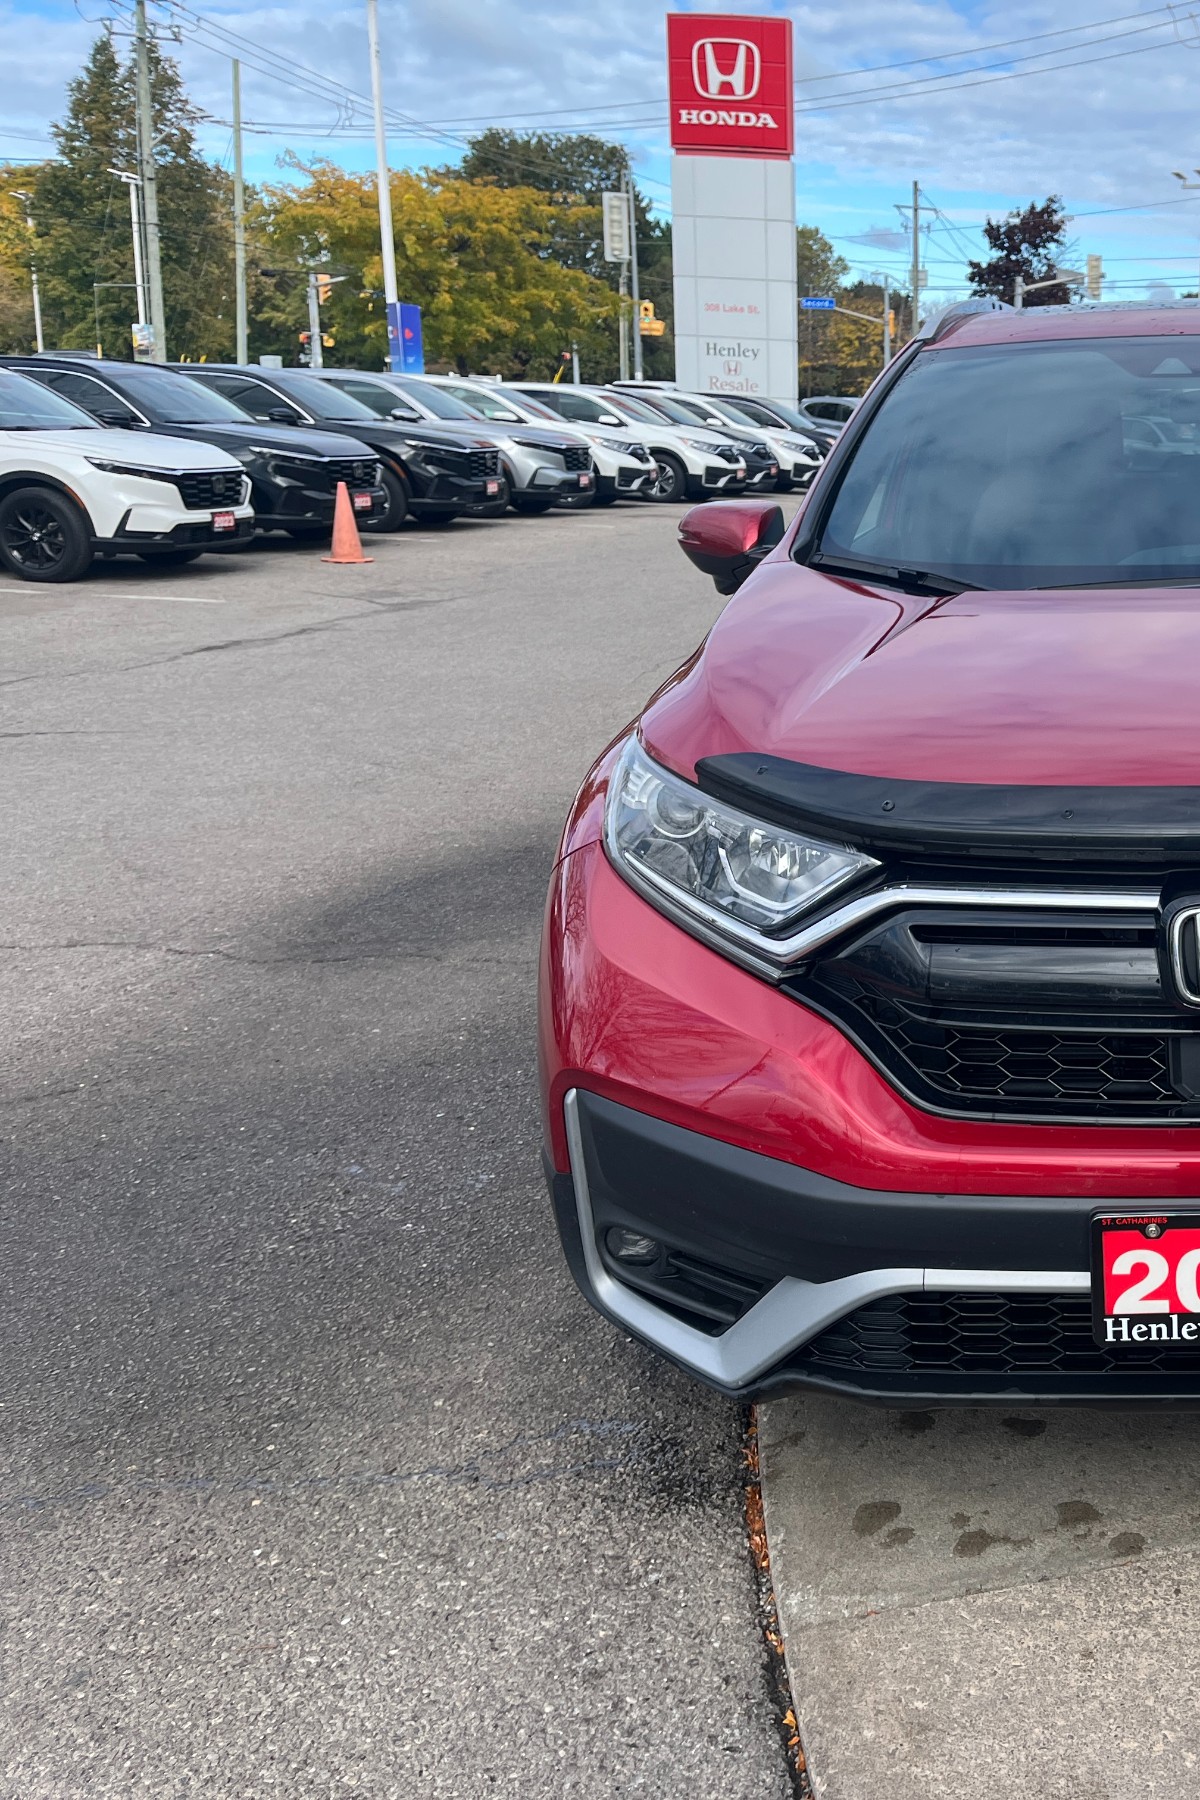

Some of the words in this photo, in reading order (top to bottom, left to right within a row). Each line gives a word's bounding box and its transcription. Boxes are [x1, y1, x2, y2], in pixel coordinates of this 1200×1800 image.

[679, 109, 779, 129] HONDA
[723, 304, 745, 314] Lake
[706, 342, 760, 361] Henley
[709, 376, 759, 393] Resale
[1102, 1218, 1115, 1226] ST.
[1116, 1217, 1168, 1225] CATHARINES
